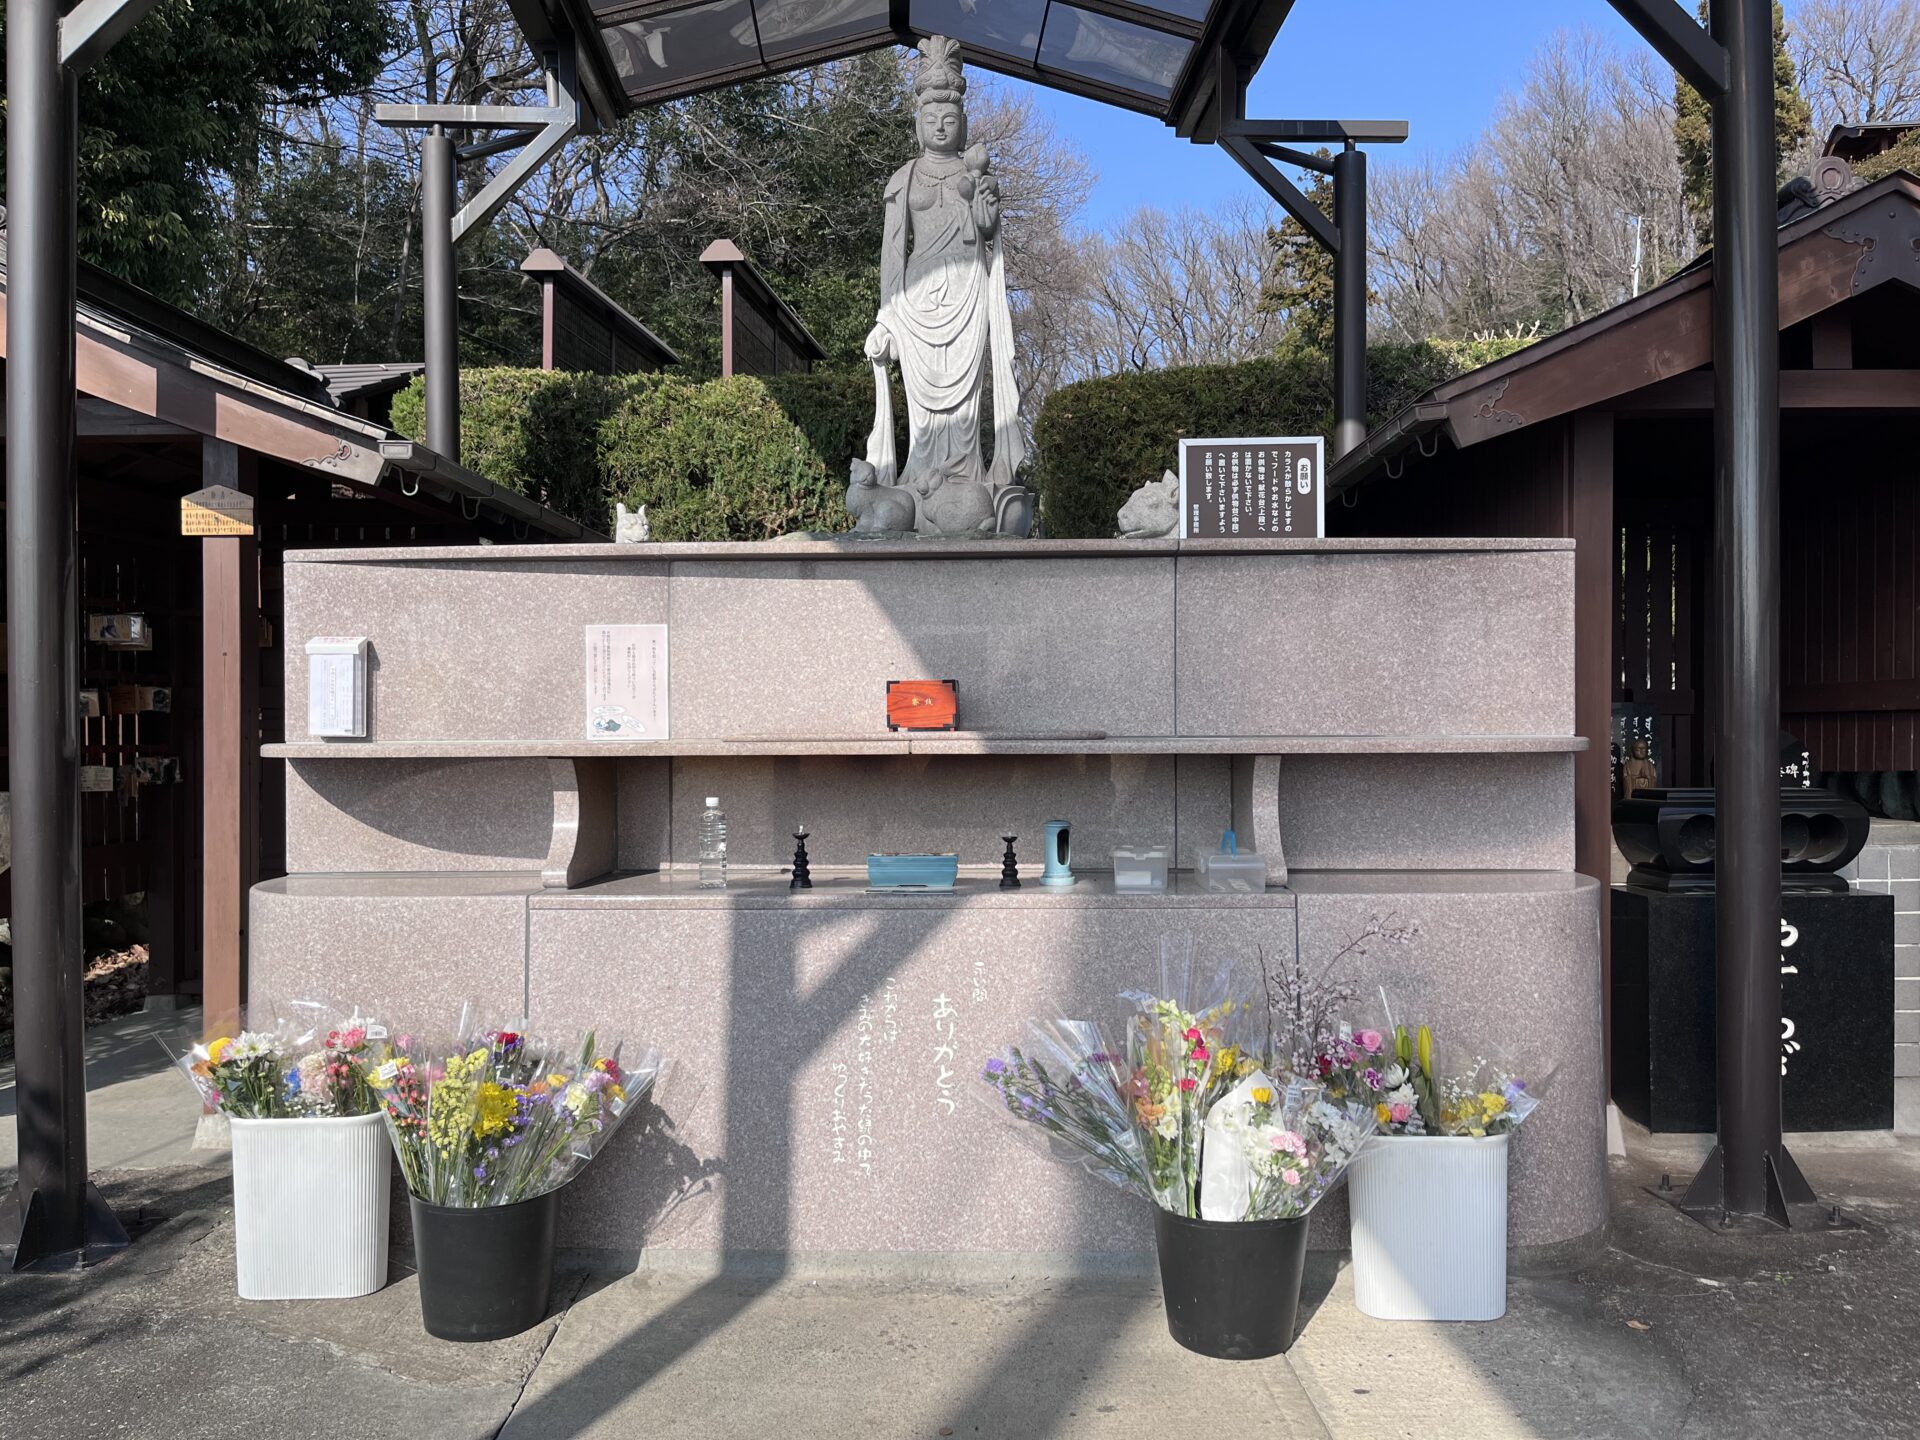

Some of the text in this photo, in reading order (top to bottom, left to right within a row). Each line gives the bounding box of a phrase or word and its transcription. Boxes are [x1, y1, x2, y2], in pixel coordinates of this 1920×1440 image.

[1204, 451, 1213, 503] お願い致します。
[1218, 452, 1226, 533] へ置いて下さいますよう
[1244, 451, 1252, 516] は置かないで下さい。
[1271, 450, 1279, 532] で、フードやお水などの
[1284, 450, 1292, 532] カラスが散らかしますの
[1300, 464, 1309, 488] お願い
[883, 976, 899, 1042] これからは
[933, 992, 959, 1115] ありがとう
[831, 1062, 848, 1164] ゆっくりおやすみ
